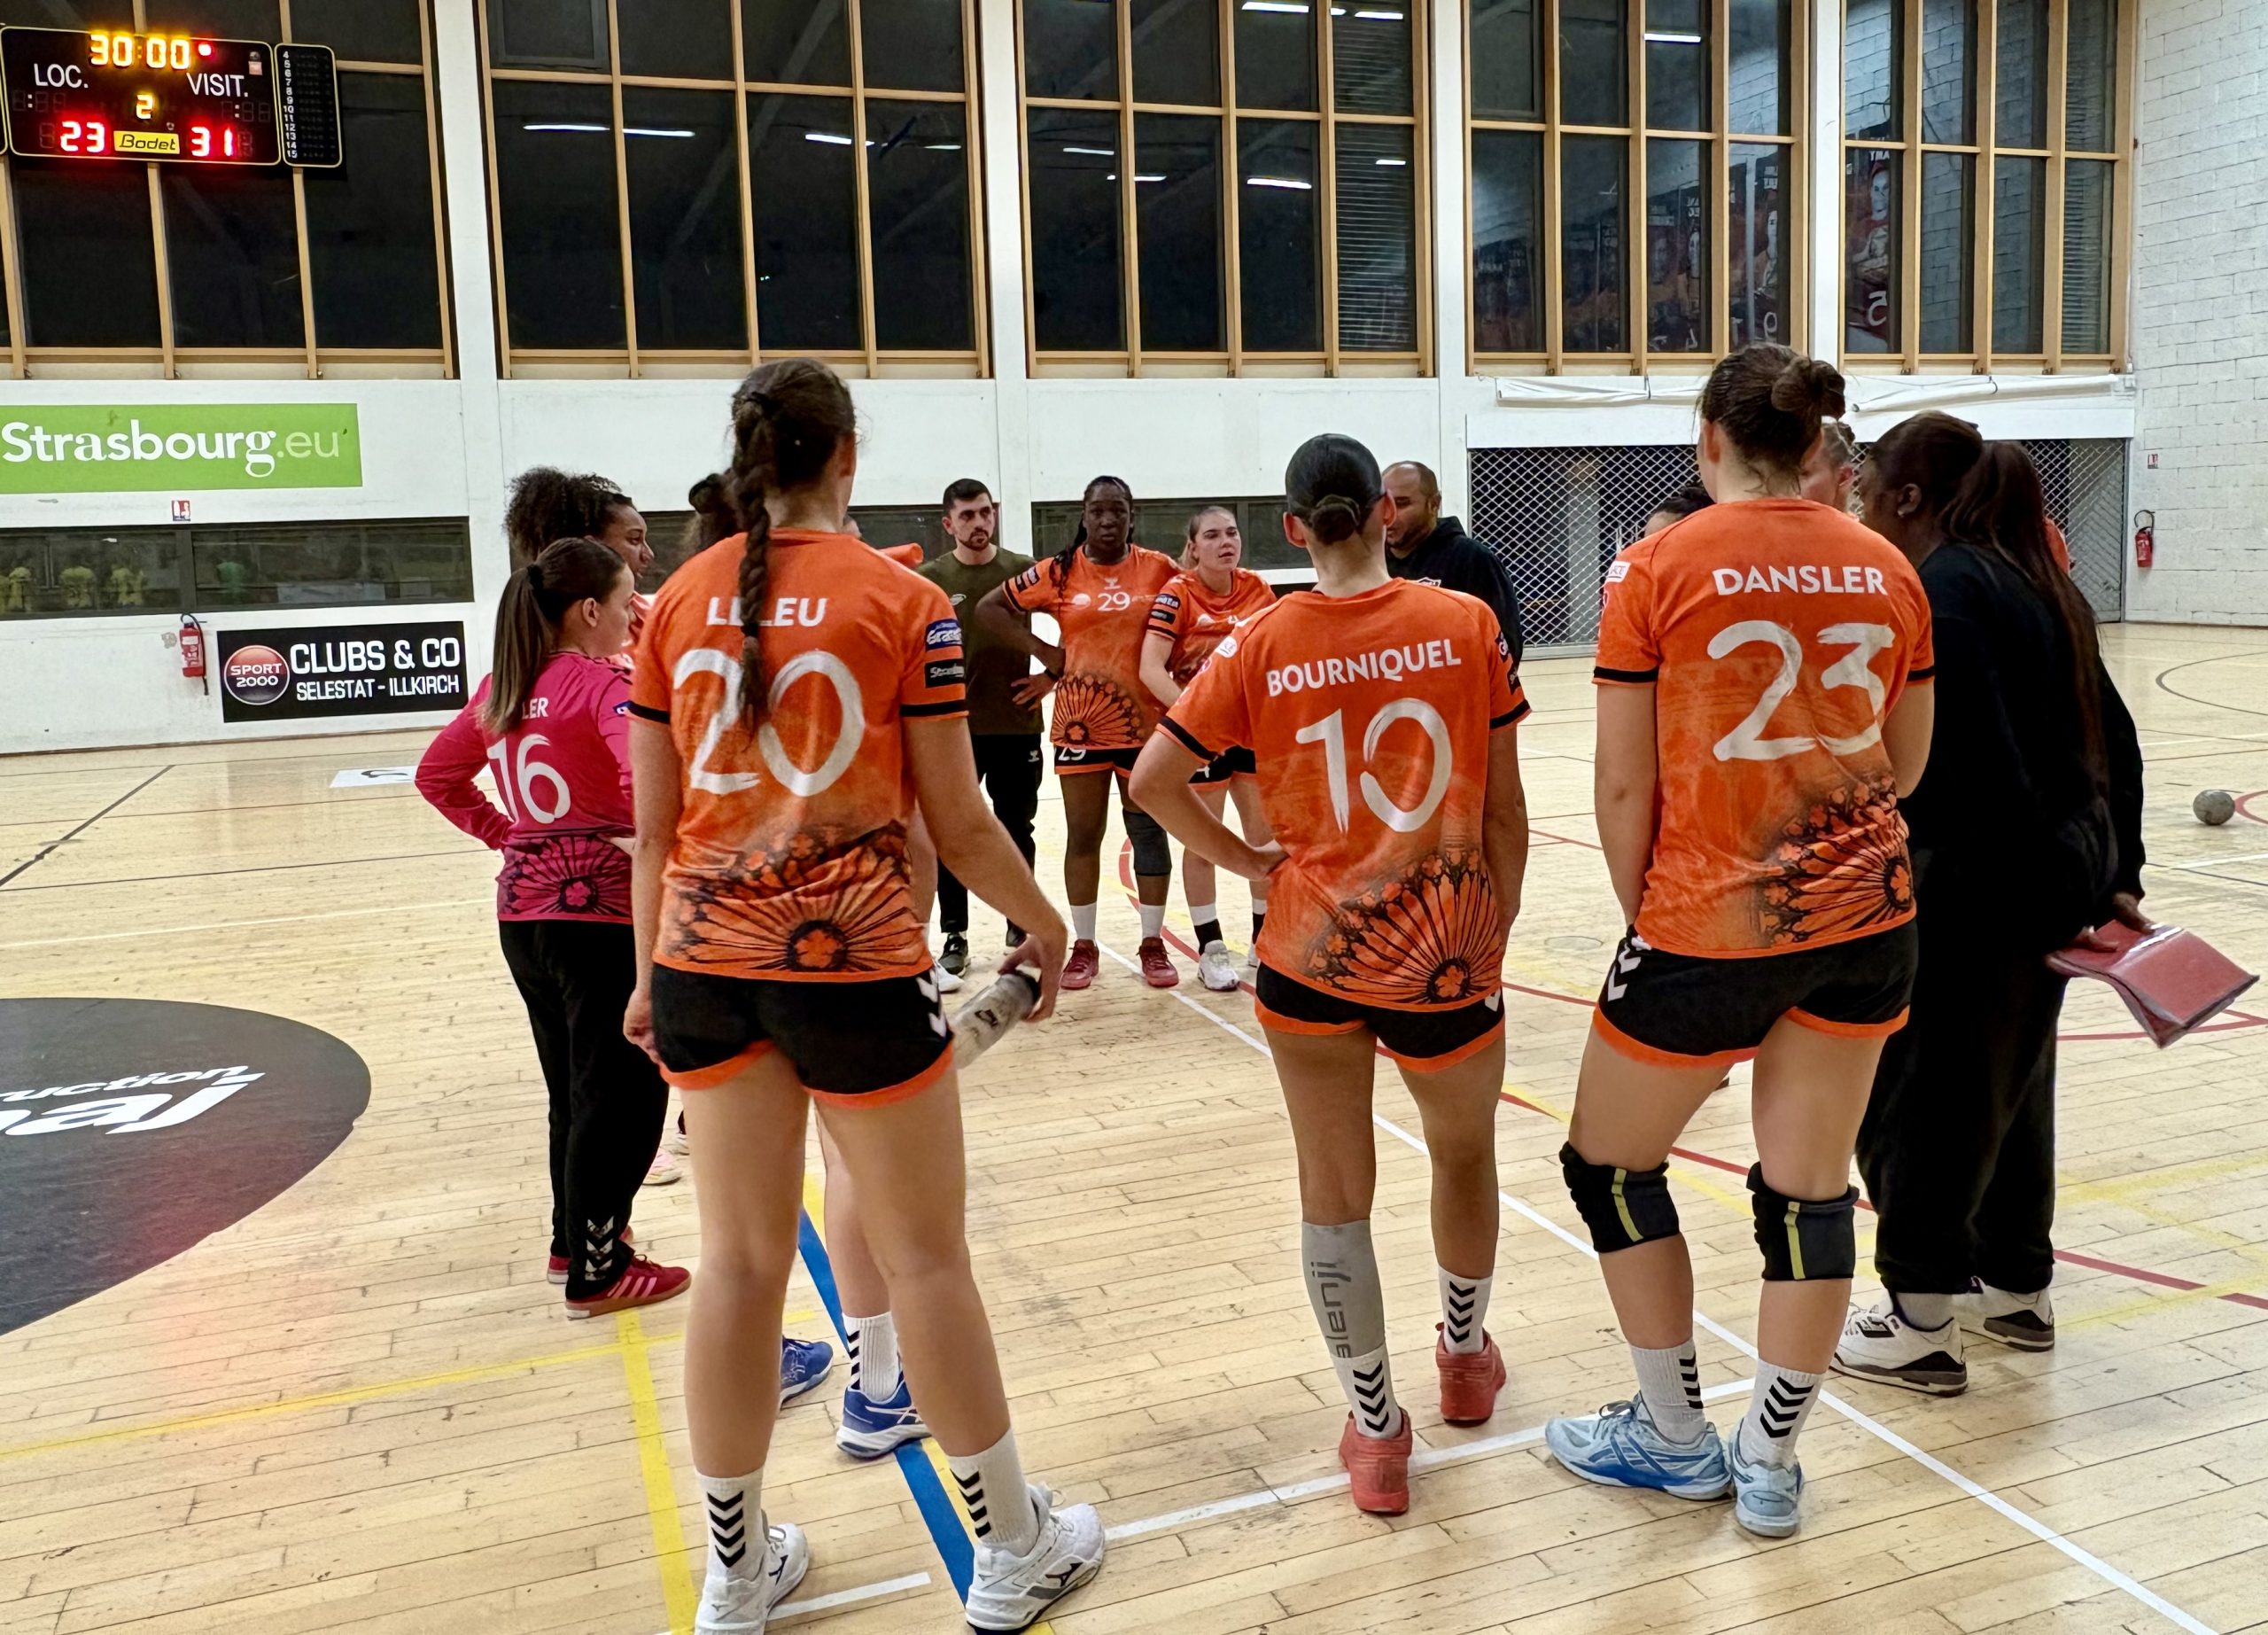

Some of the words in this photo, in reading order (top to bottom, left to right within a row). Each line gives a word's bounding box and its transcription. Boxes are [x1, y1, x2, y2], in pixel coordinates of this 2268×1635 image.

[90, 34, 190, 70] 30:00
[34, 63, 89, 88] LOC.
[186, 72, 248, 97] VISIT.
[136, 94, 153, 120] 2
[60, 121, 105, 152] 23
[120, 134, 176, 151] Bodet
[190, 126, 233, 157] 31
[2, 419, 340, 478] Strasbourg.eu
[1712, 564, 1888, 596] DANSLER
[1098, 591, 1130, 611] 29
[230, 663, 282, 676] SPORT
[290, 640, 385, 674] CLUBS
[393, 639, 415, 669] &
[421, 637, 460, 668] CO
[1265, 639, 1461, 697] BOURNIQUEL
[236, 675, 279, 688] 2000
[297, 679, 375, 701] SELESTAT
[389, 674, 460, 697] ILLKIRCH
[1706, 619, 1896, 761] 23
[672, 648, 865, 797] 20
[487, 734, 571, 824] 16
[1295, 697, 1452, 835] 10
